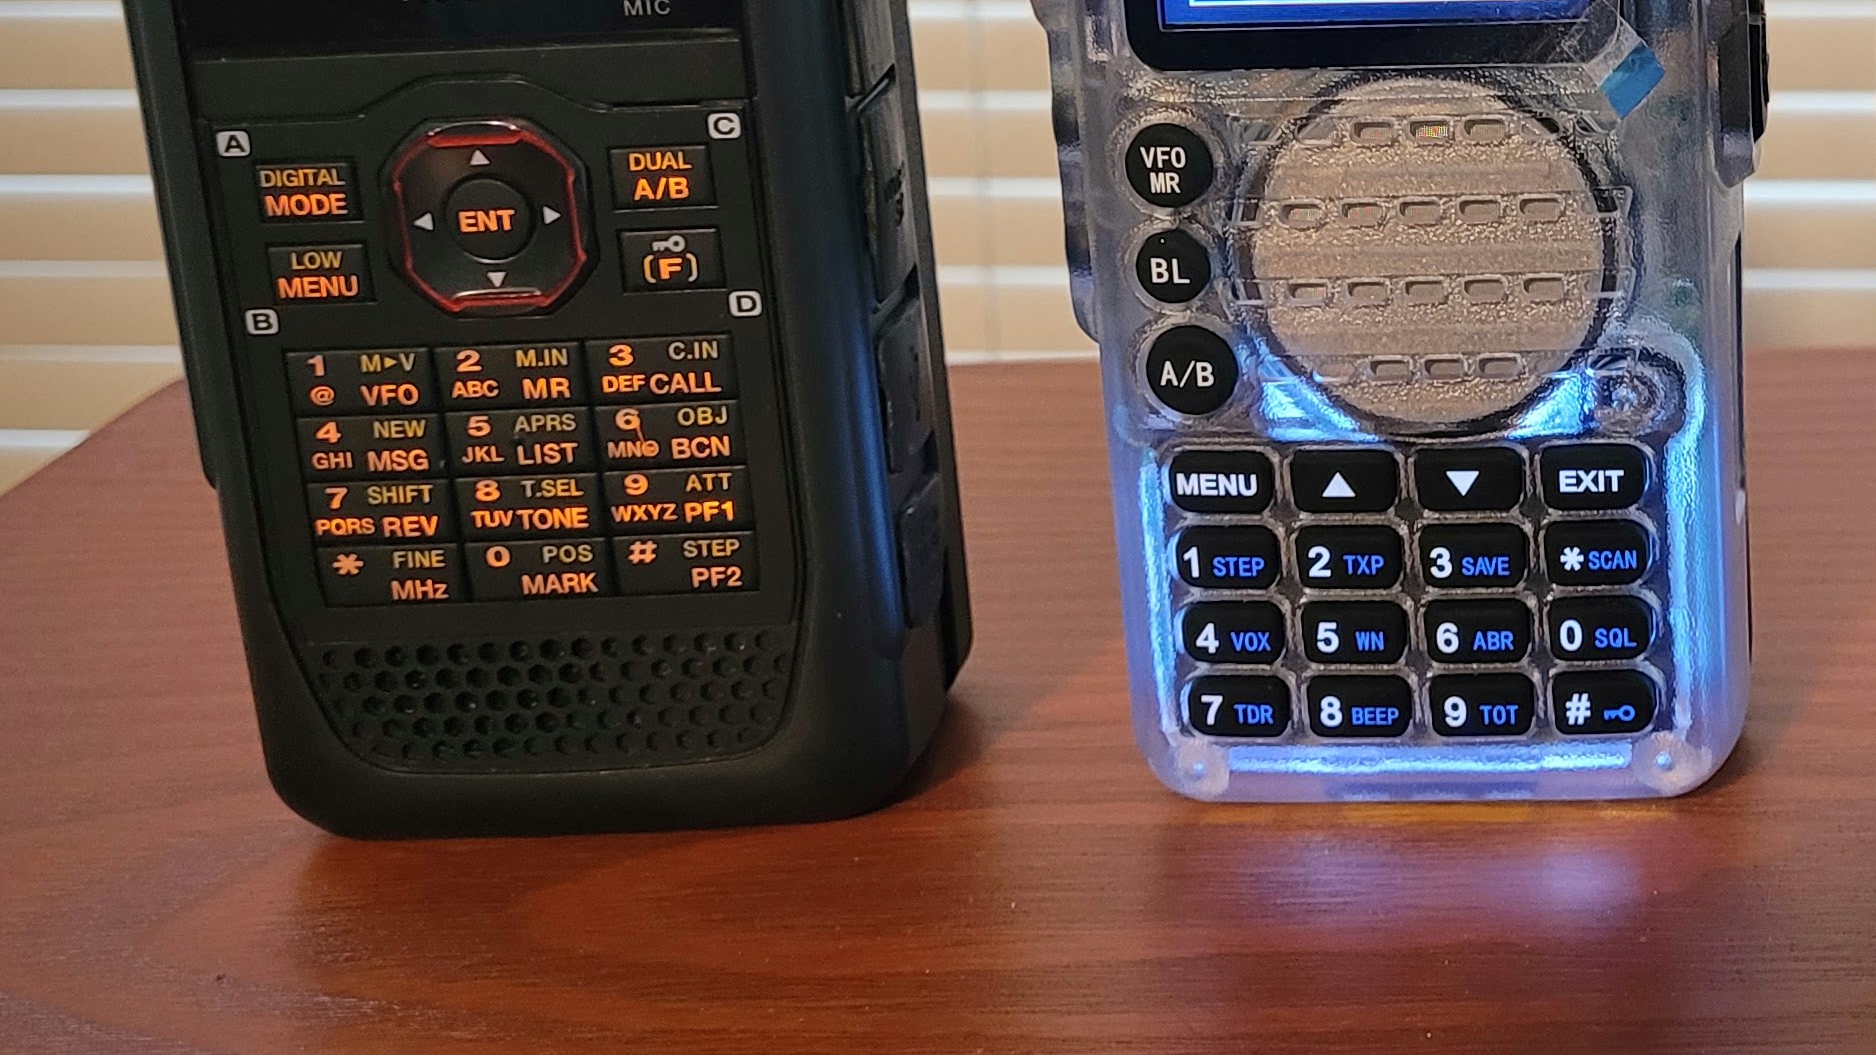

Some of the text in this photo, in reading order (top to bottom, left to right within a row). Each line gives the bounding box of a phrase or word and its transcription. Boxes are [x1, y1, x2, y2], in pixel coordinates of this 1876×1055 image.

[628, 151, 693, 172] DUAL
[1140, 145, 1187, 170] VFO
[259, 167, 346, 188] DIGITAL
[633, 176, 690, 201] A/B
[1149, 172, 1182, 195] MR
[263, 193, 349, 217] MODE
[458, 209, 516, 233] ENT
[290, 251, 342, 270] LOW
[1150, 258, 1190, 284] BL
[276, 275, 359, 299] MENU
[515, 347, 569, 368] M.IN
[667, 340, 719, 360] C.IN
[601, 371, 722, 395] DEF CALL
[1160, 360, 1216, 388] A/B
[359, 382, 420, 407] VFO
[451, 376, 572, 400] ABC MR
[372, 418, 426, 439] NEW
[513, 412, 577, 434] APRS
[676, 406, 728, 427] OBJ
[462, 442, 579, 466] JKL LIST
[670, 435, 732, 460] BCN
[311, 449, 430, 472] GHI MSG
[520, 477, 585, 498] T.SEL
[685, 472, 733, 493] ATT
[1175, 473, 1258, 497] MENU
[1558, 469, 1625, 492] EXIT
[366, 484, 434, 506] SHIFT
[470, 507, 590, 531] TUV TONE
[610, 500, 735, 524] WXYZ PF1
[313, 515, 439, 538] PQRS REV
[392, 548, 446, 569] FINE
[542, 544, 594, 564] POS
[682, 538, 740, 559] STEP
[1587, 549, 1638, 570] SCAN
[1182, 546, 1265, 578] 1 STEP
[1307, 545, 1385, 578] 2 TXP
[1429, 546, 1511, 579] 3 SAVE
[521, 571, 599, 596] MARK
[691, 565, 743, 589] PF2
[390, 578, 450, 602] MHz
[1195, 622, 1272, 654] 4 VOX
[1316, 621, 1385, 654] 5 WN
[1435, 622, 1515, 654] 6 ABR
[1559, 619, 1638, 652] 0 SQL
[1200, 694, 1274, 726] 7 TDR
[1319, 695, 1400, 728] 8 BEEP
[1443, 695, 1519, 728] 9 TOT
